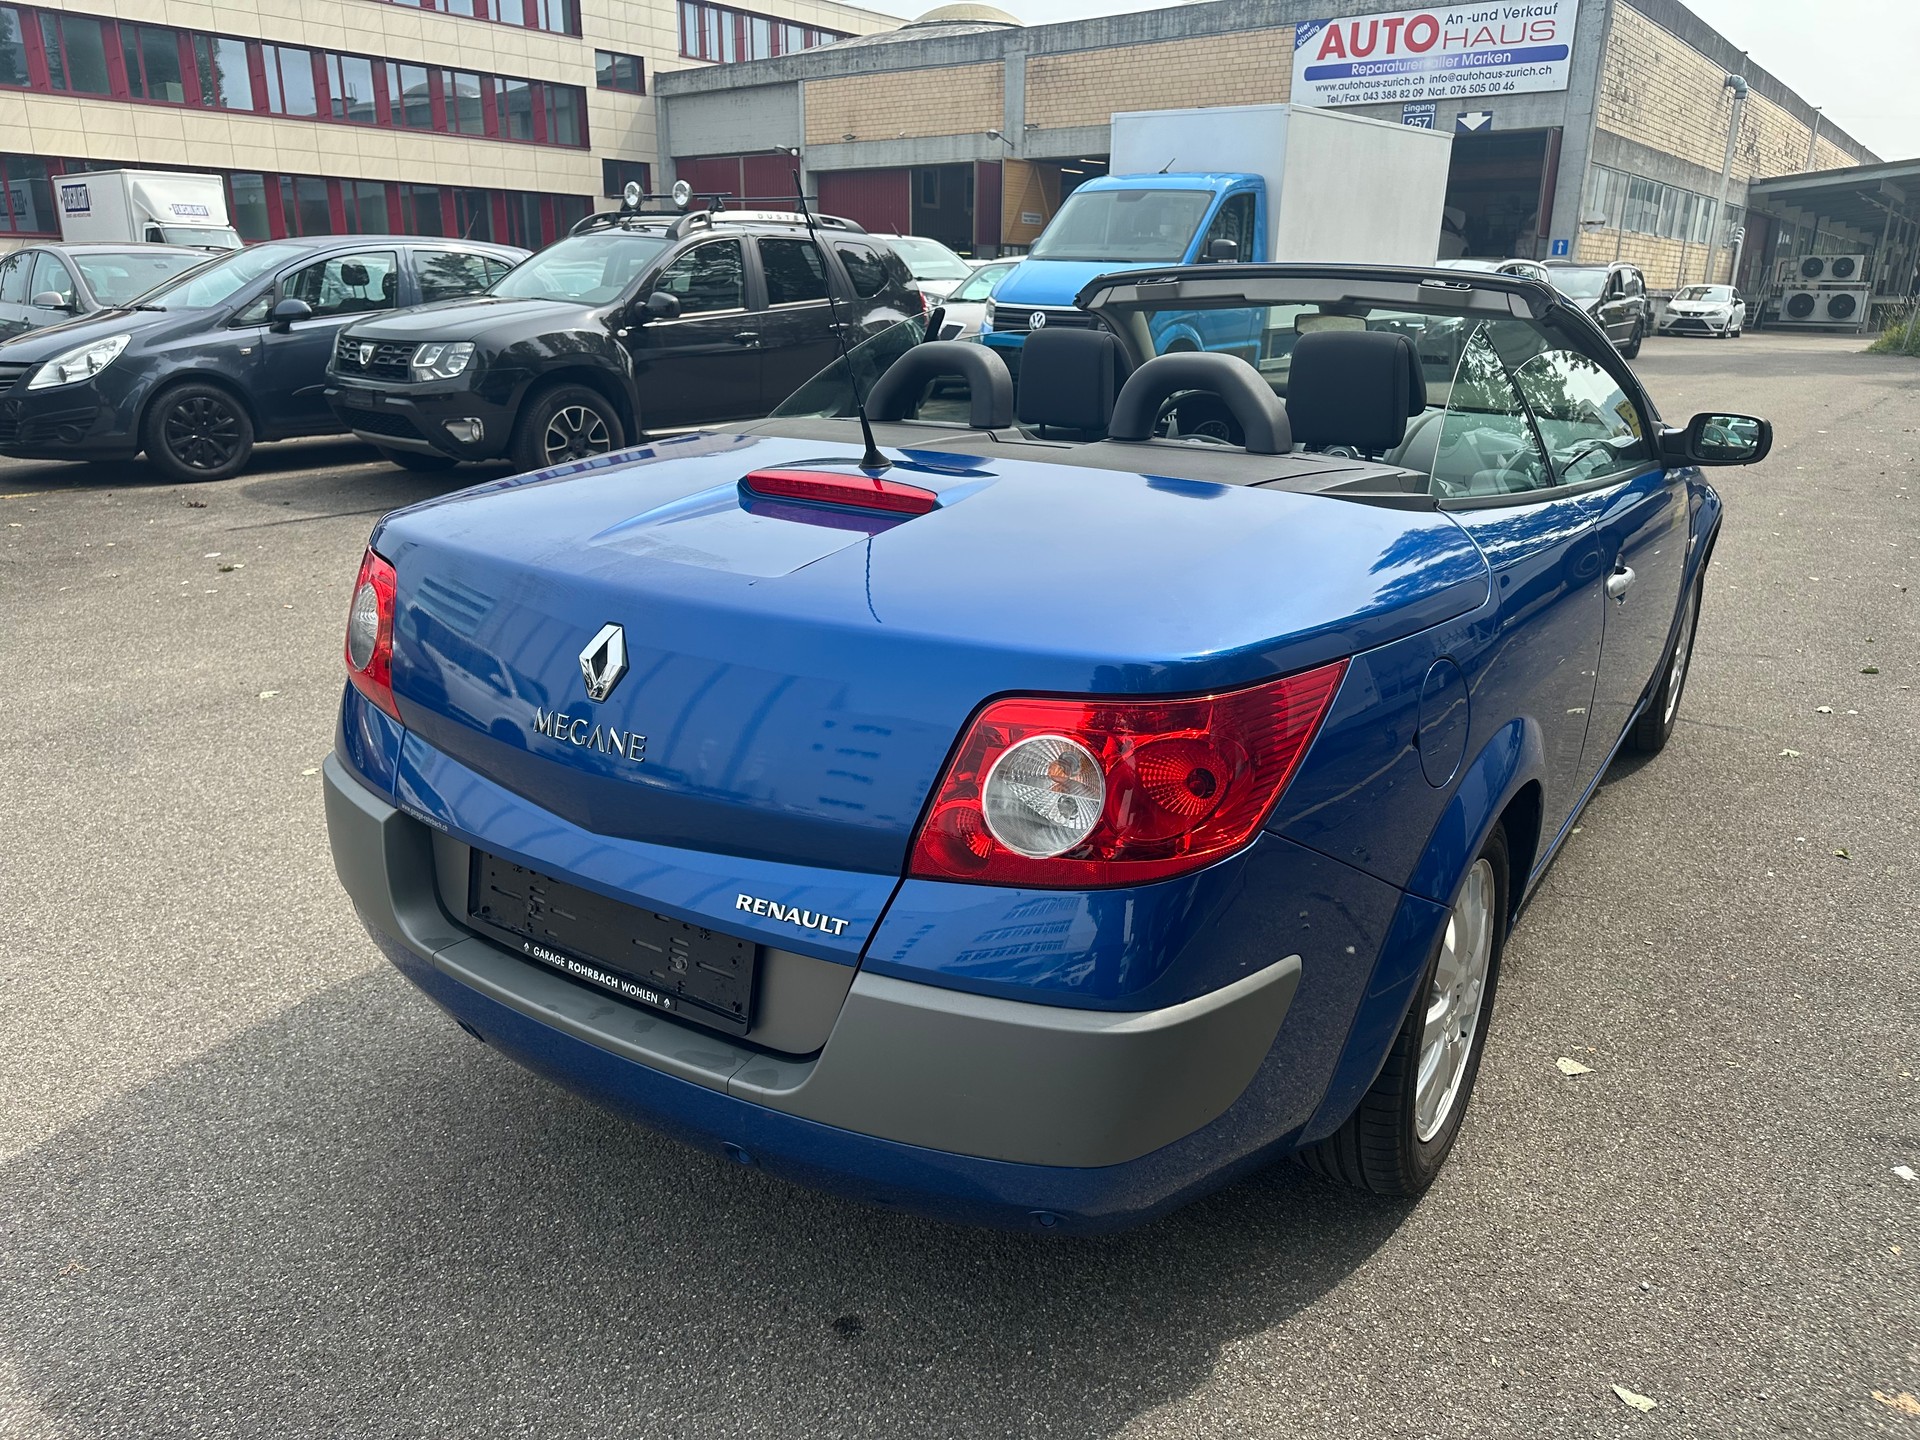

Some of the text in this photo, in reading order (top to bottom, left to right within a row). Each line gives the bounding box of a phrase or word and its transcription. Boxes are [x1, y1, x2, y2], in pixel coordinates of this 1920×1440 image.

[1445, 3, 1558, 25] An -und Verkauf
[1296, 25, 1320, 47] günstig
[1297, 22, 1310, 35] Hier
[1316, 14, 1555, 60] AUTO HAUS
[1432, 56, 1459, 69] aller
[1462, 52, 1511, 66] Marken
[1315, 65, 1552, 91] www.autohaus-zurich.ch info@autohaus-zurich.ch
[1327, 81, 1515, 104] Tel./Fax 043 388 82 09 Nat. 076 505 00 46
[1403, 103, 1436, 113] Eingang
[1407, 117, 1430, 128] 257
[533, 706, 648, 763] MEGANE
[401, 803, 448, 832] www.garage-rohrbach.ch
[735, 893, 850, 936] RENAULT
[533, 946, 659, 1004] GARAGE ROHRBACH WOHLEN
